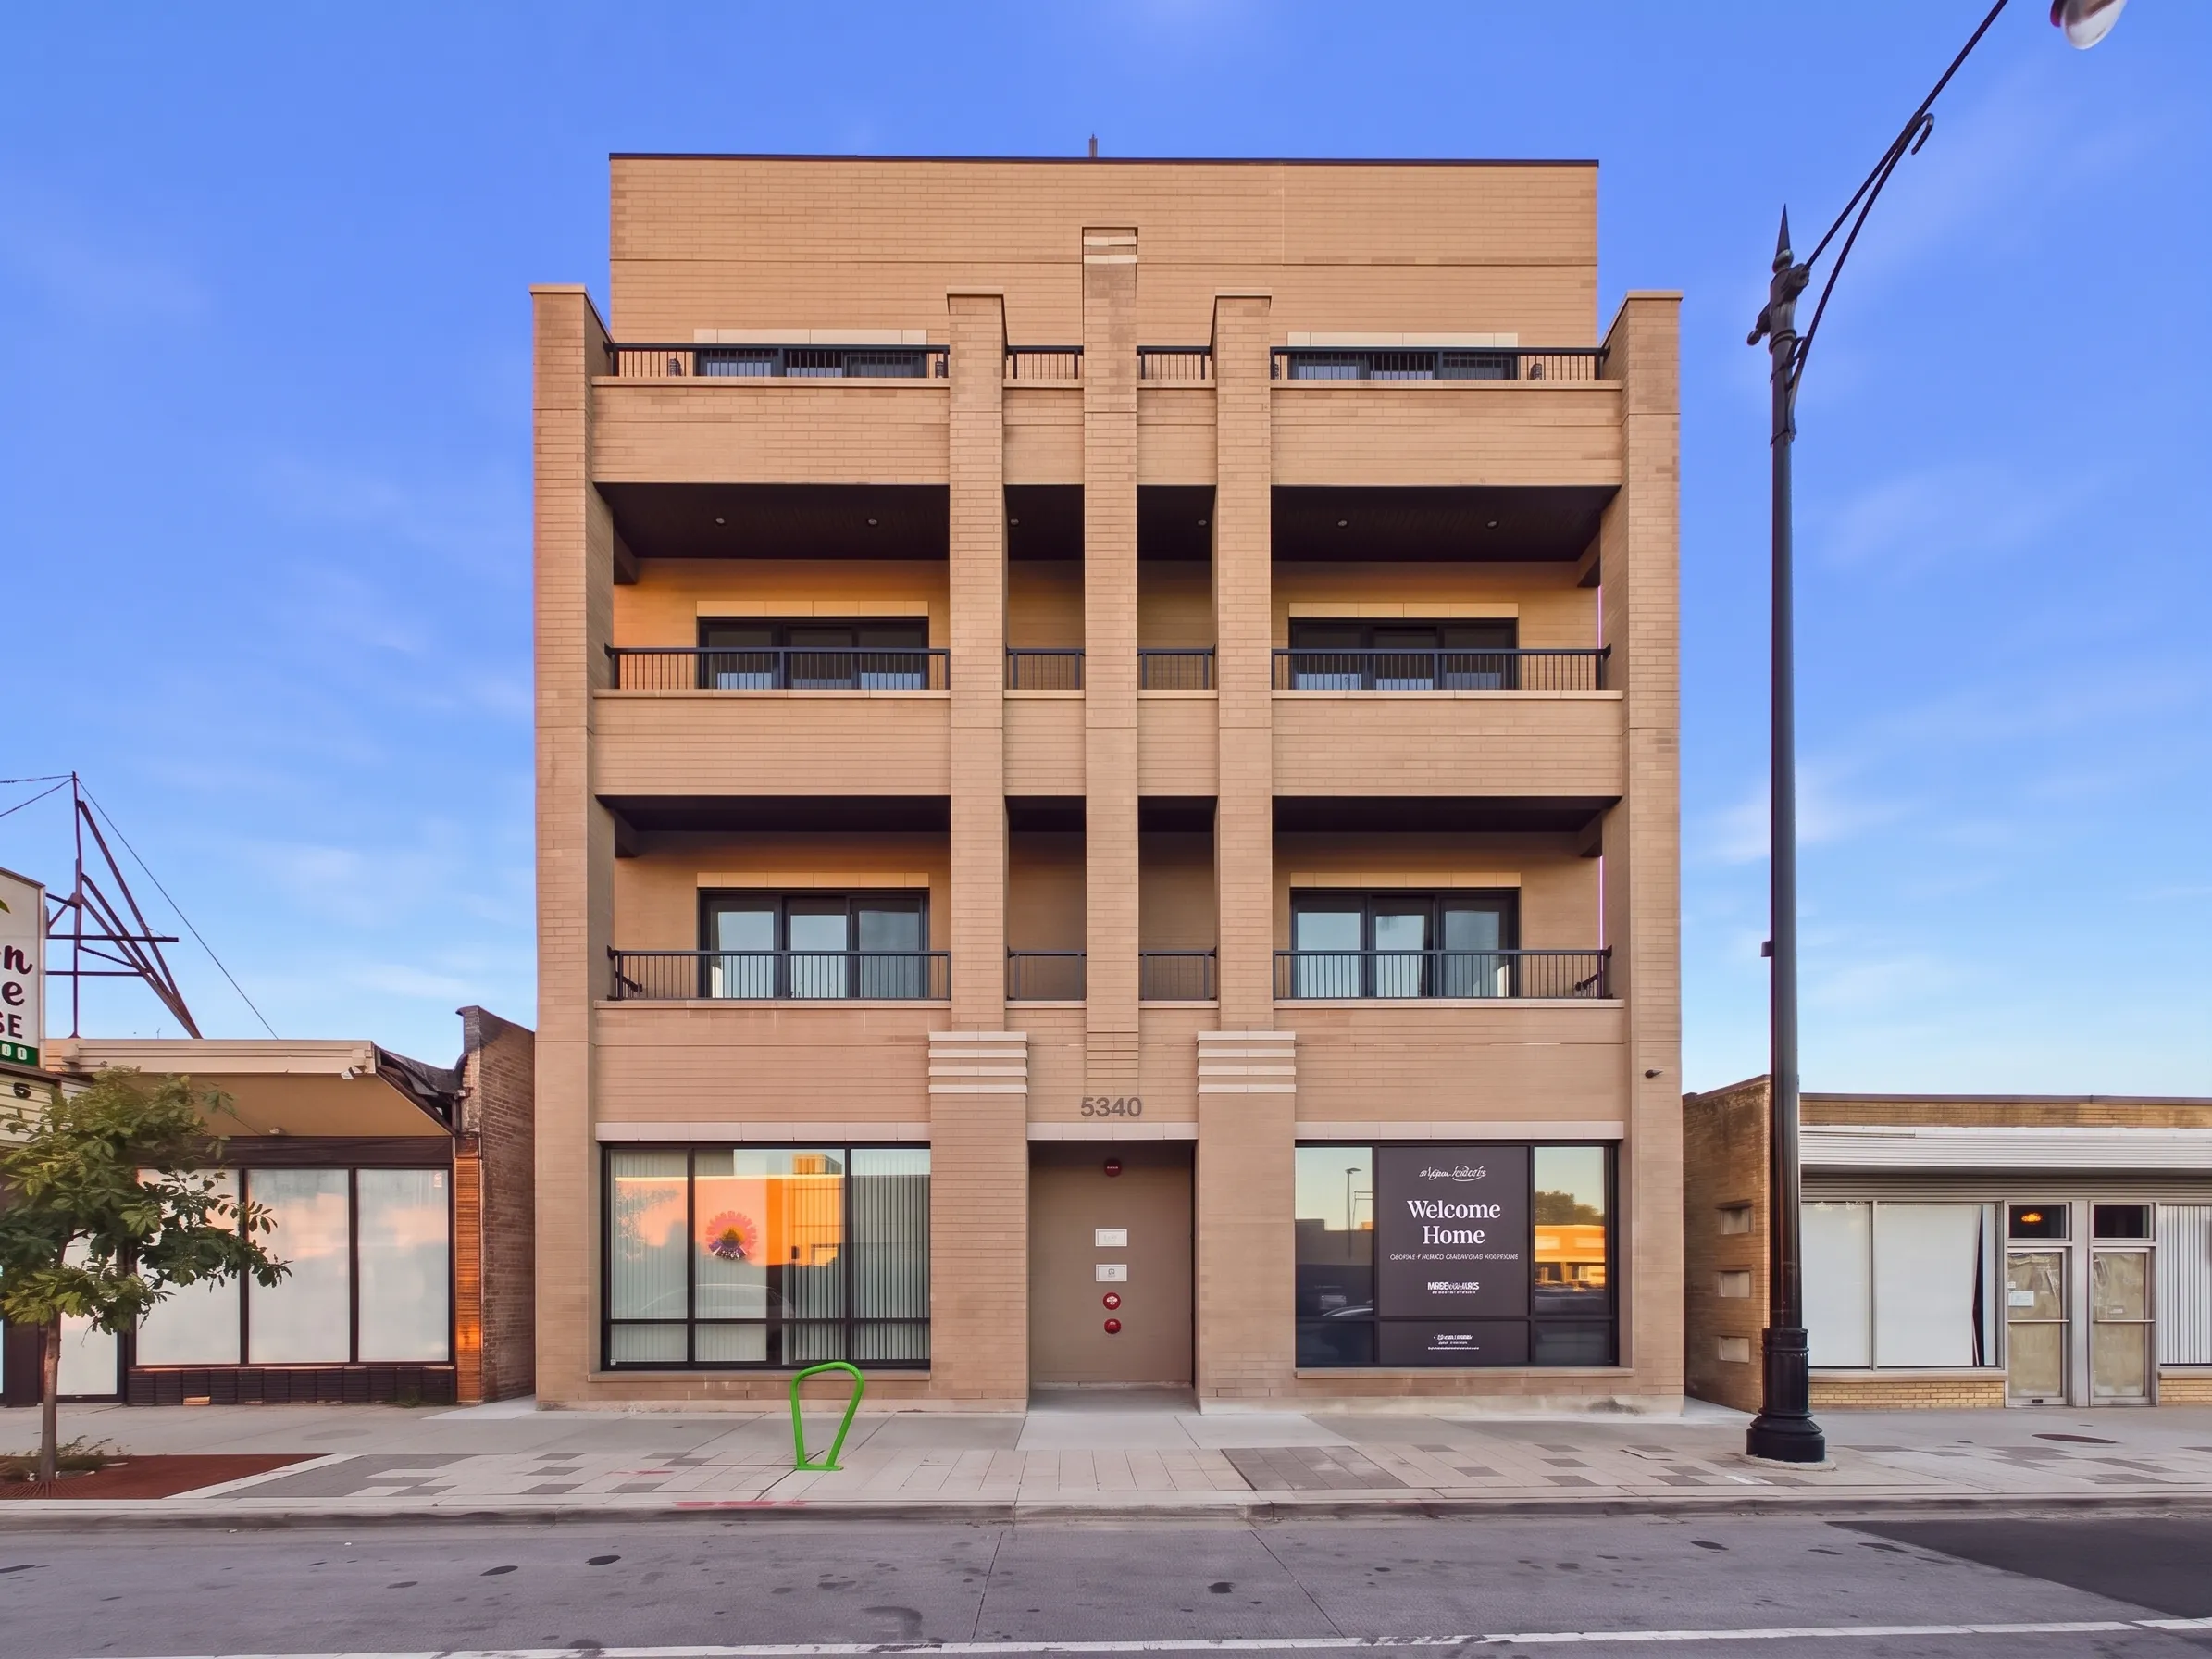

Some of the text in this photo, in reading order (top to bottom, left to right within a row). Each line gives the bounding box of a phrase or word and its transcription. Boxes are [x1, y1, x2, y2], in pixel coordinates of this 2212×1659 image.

[2, 981, 25, 1006] e
[1081, 1097, 1142, 1117] 5340
[1407, 1200, 1501, 1219] Welcome
[1423, 1225, 1485, 1244] Home
